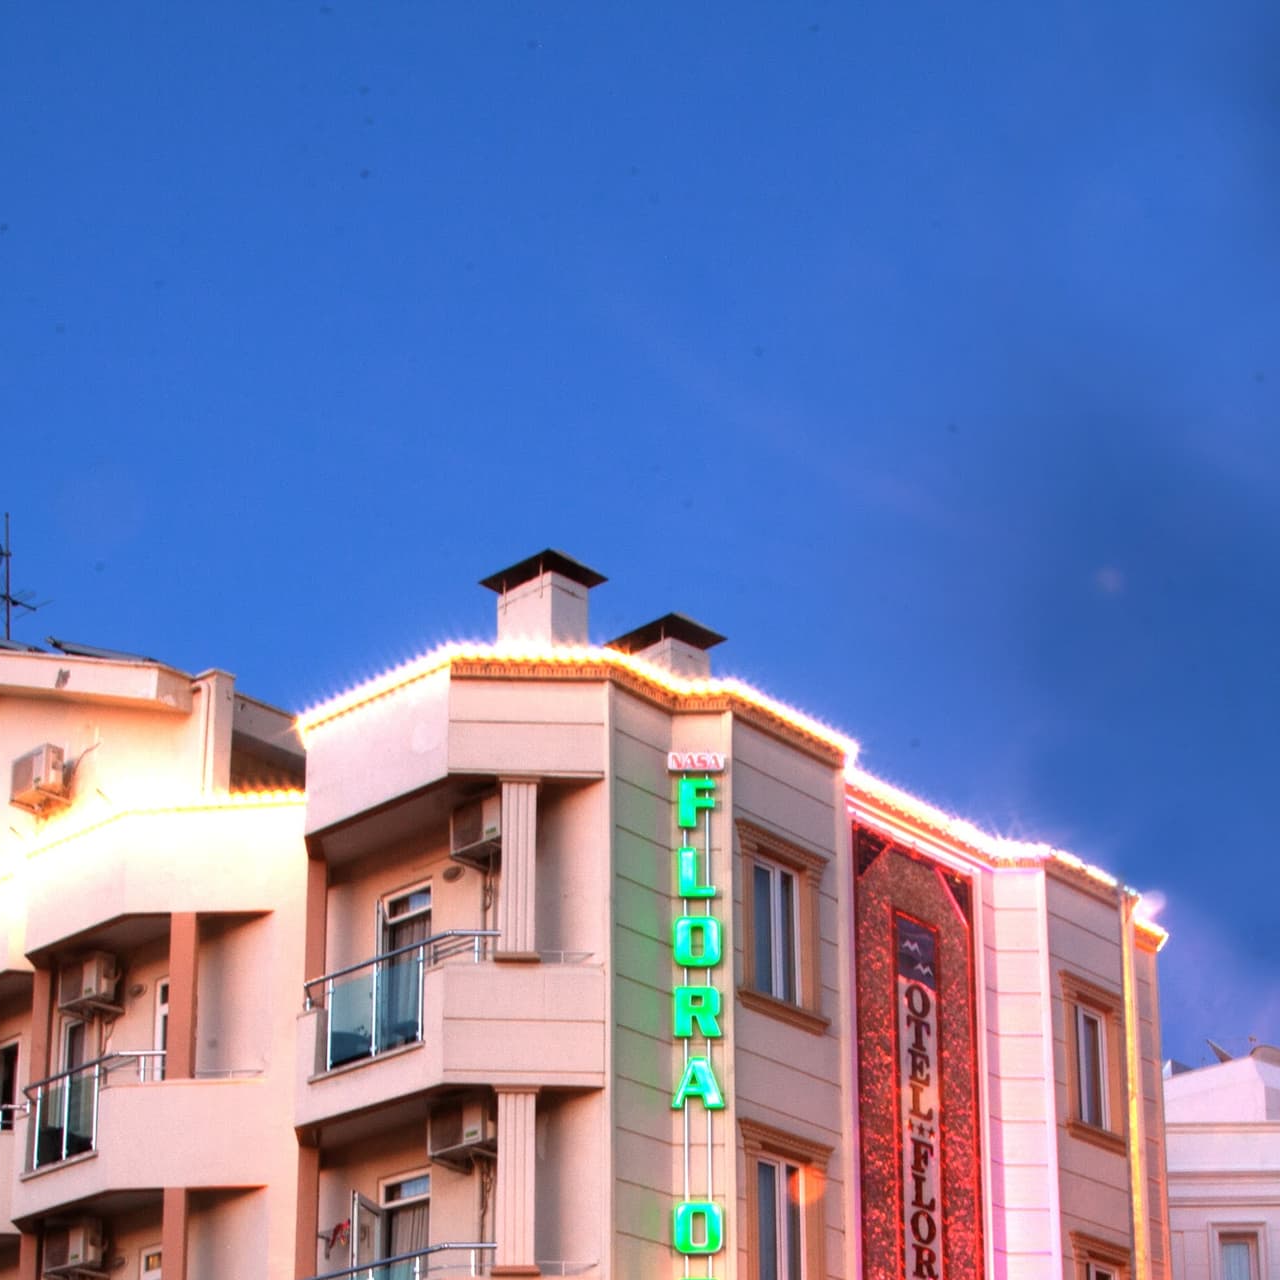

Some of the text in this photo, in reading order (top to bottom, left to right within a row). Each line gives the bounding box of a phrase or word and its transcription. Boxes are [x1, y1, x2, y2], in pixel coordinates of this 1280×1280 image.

[670, 753, 722, 769] NASA
[672, 777, 724, 1110] FLORA
[904, 984, 934, 1121] OTEL
